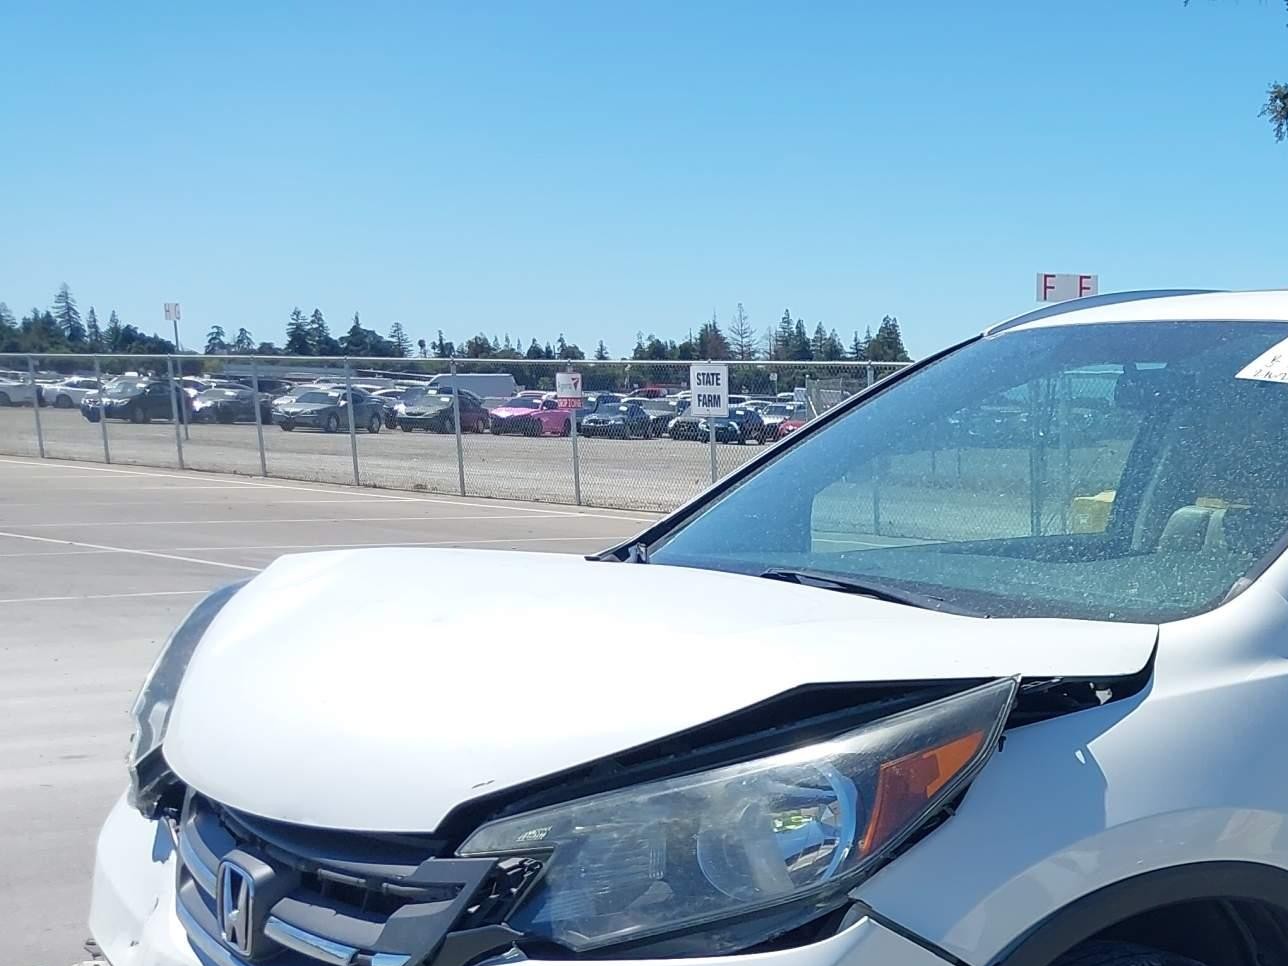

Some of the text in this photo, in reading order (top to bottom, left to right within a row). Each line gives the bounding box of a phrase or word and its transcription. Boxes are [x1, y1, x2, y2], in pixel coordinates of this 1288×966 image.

[1043, 273, 1056, 301] F
[696, 372, 721, 386] STATE
[697, 393, 721, 408] FARM
